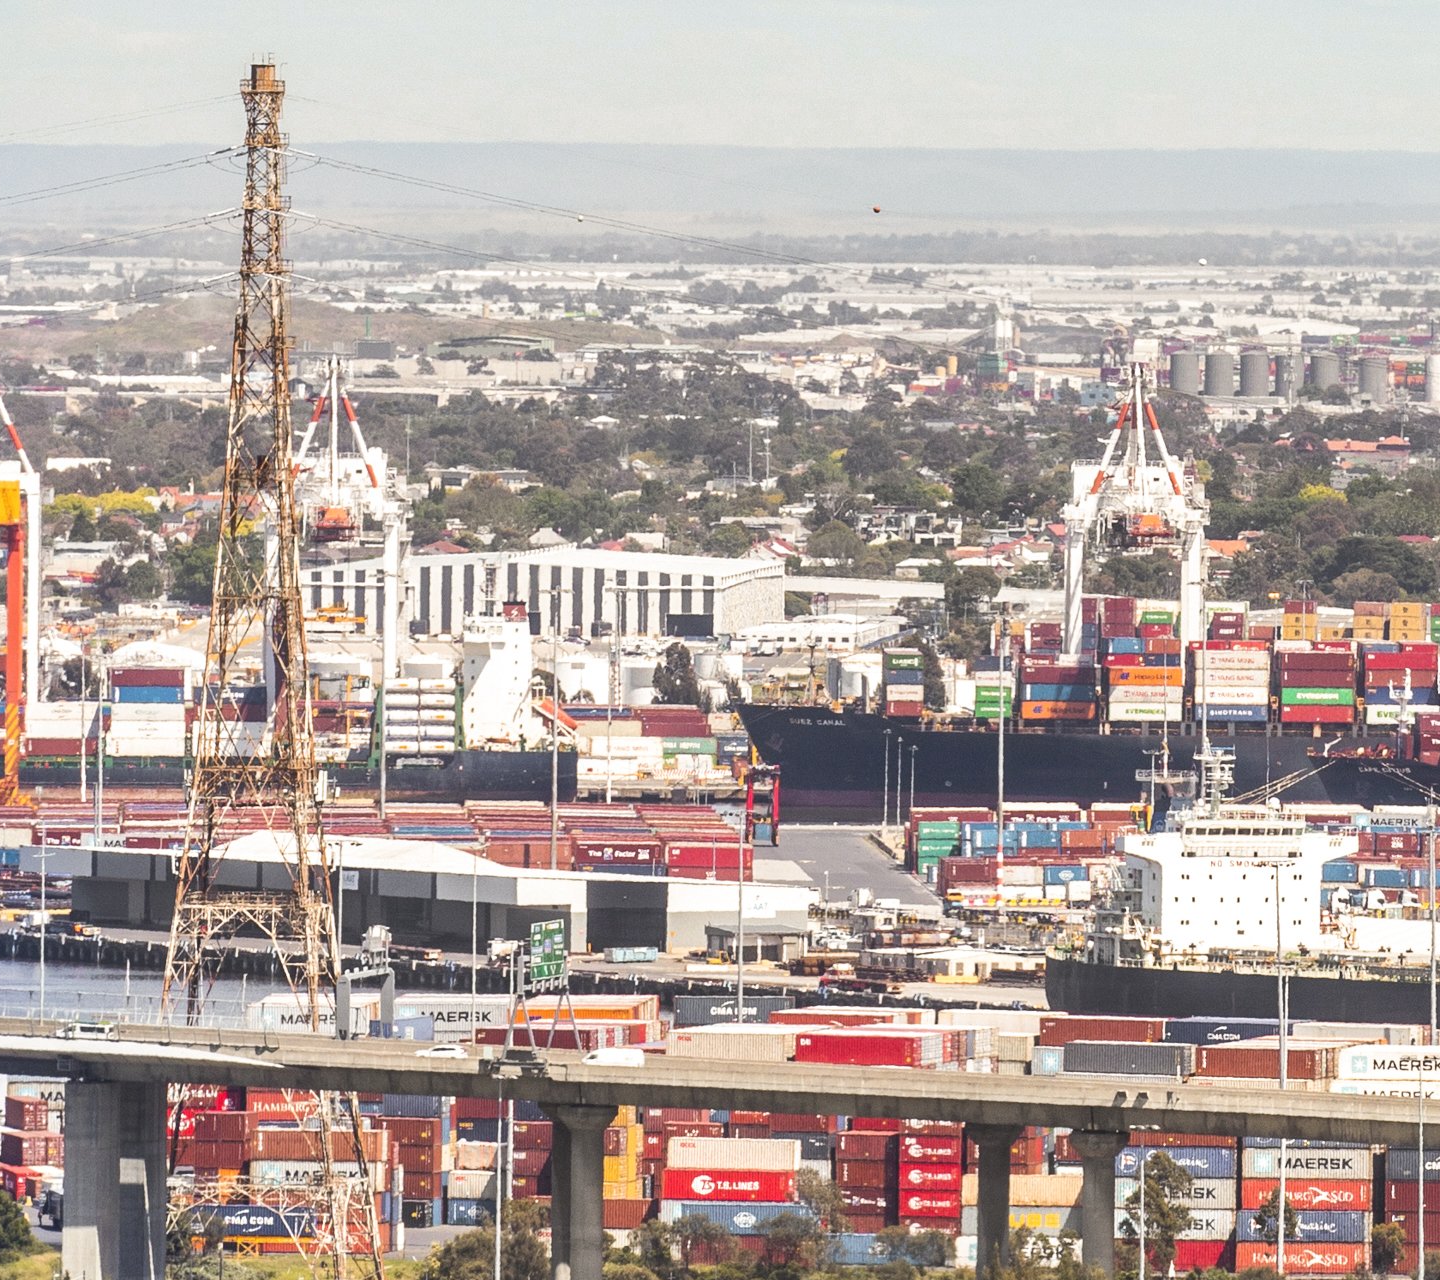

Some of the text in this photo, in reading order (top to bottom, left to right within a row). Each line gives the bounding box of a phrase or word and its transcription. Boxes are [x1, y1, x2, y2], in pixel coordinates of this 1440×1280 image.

[1370, 817, 1419, 827] MAERSK
[1210, 860, 1223, 868] NO
[421, 1011, 492, 1022] MAERSK
[1278, 1158, 1353, 1170] MAERSK
[225, 1216, 248, 1226] CMA
